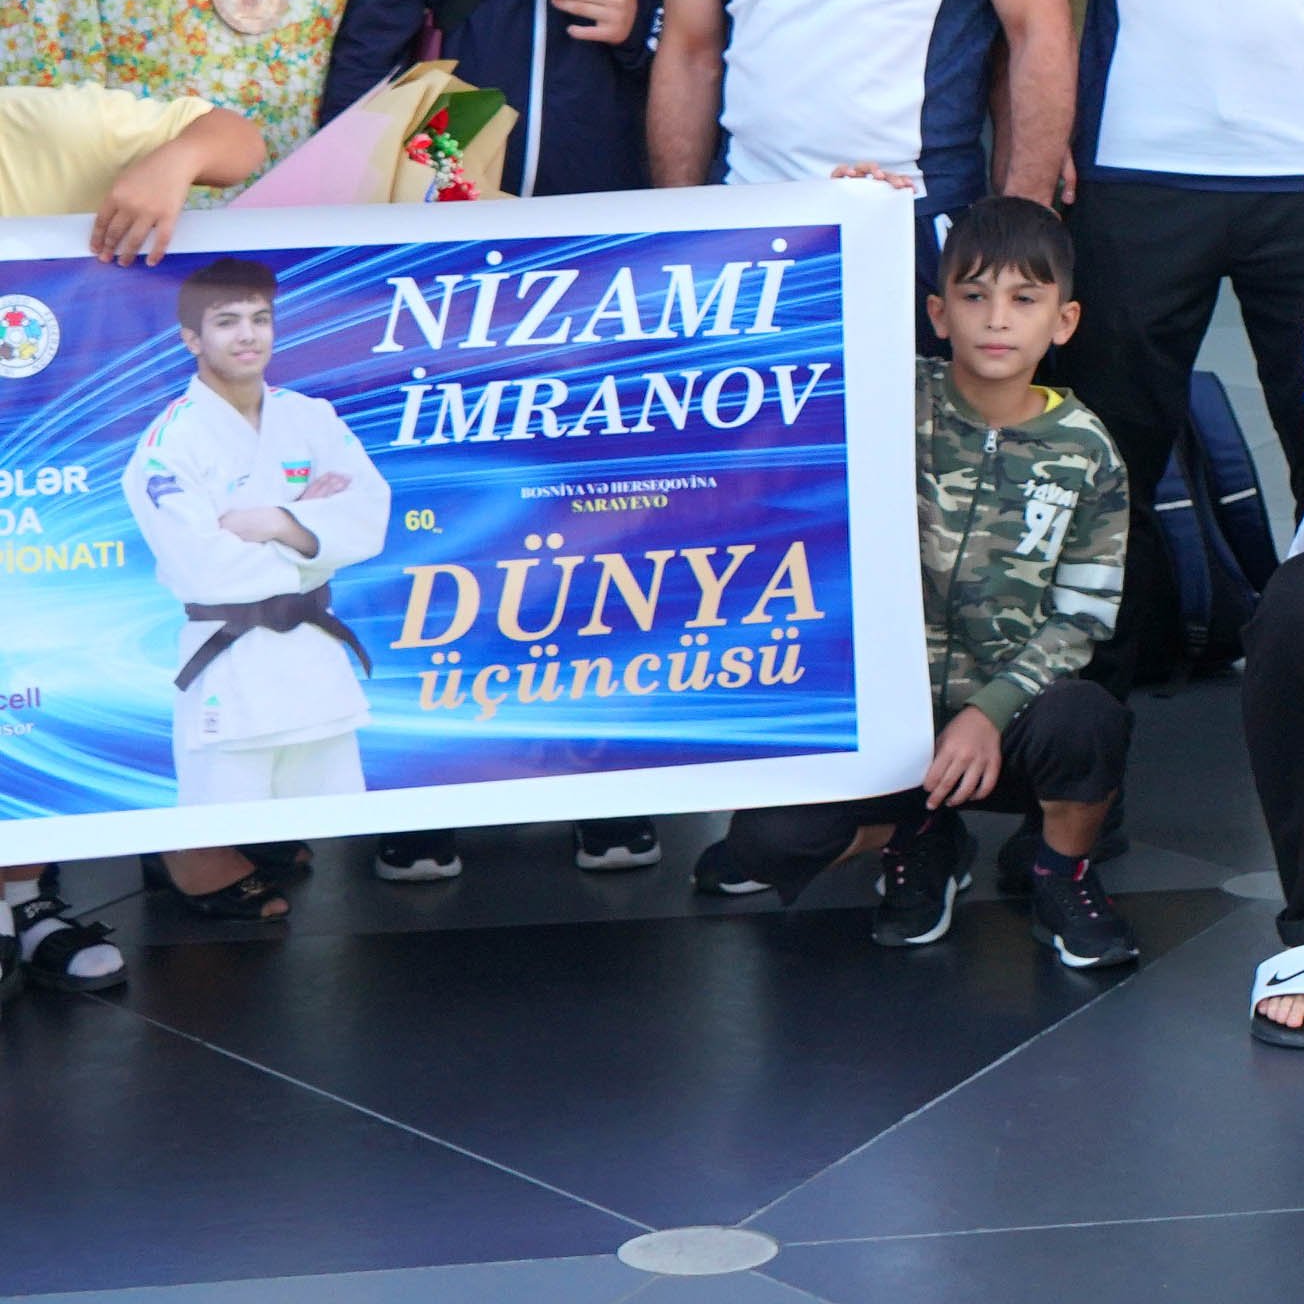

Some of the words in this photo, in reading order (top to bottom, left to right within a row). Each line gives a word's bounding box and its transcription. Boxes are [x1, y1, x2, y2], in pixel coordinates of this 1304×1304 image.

[372, 238, 796, 353] NİZAMİ
[390, 363, 832, 447] İMRANOV
[404, 509, 435, 531] 60
[520, 481, 585, 499] BOSNİYA
[610, 474, 718, 495] HERSEQOVİNA
[571, 494, 669, 513] SARAYEVO
[390, 533, 825, 650] DÜNYA
[418, 627, 806, 722] üçüncüsü
